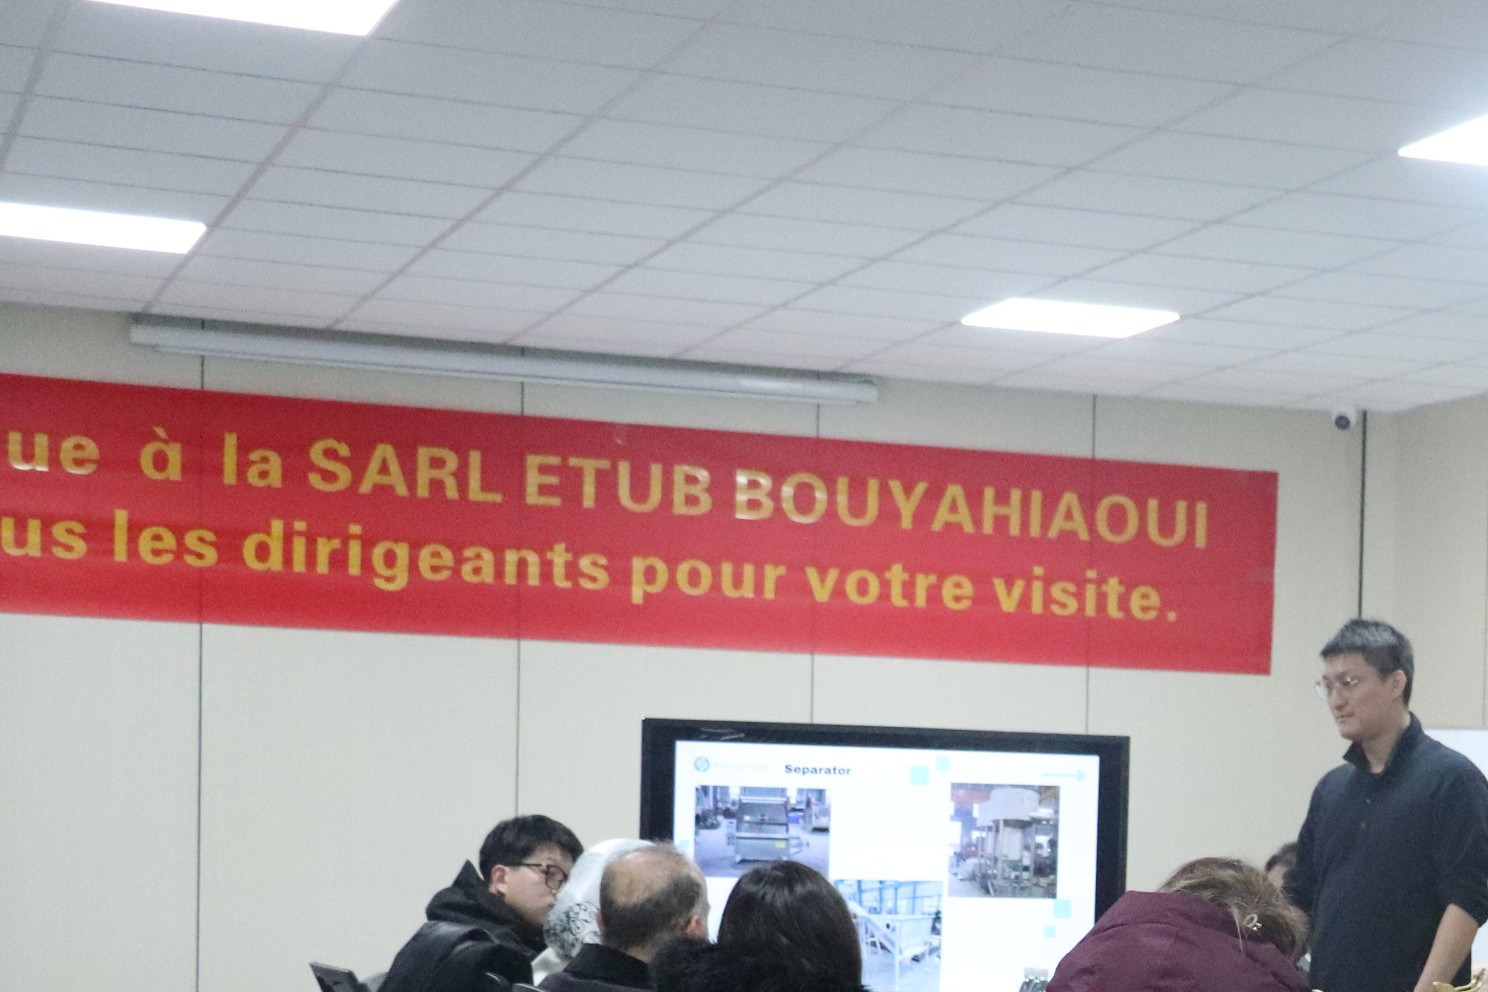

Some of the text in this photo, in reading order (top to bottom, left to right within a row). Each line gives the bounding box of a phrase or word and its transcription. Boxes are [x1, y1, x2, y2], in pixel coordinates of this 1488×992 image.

[7, 425, 1208, 549] ue à la SARL ETUB BOUYAHIAOUI
[0, 508, 1179, 622] us les dirigeants pour votre visite.
[784, 763, 852, 776] Separator
